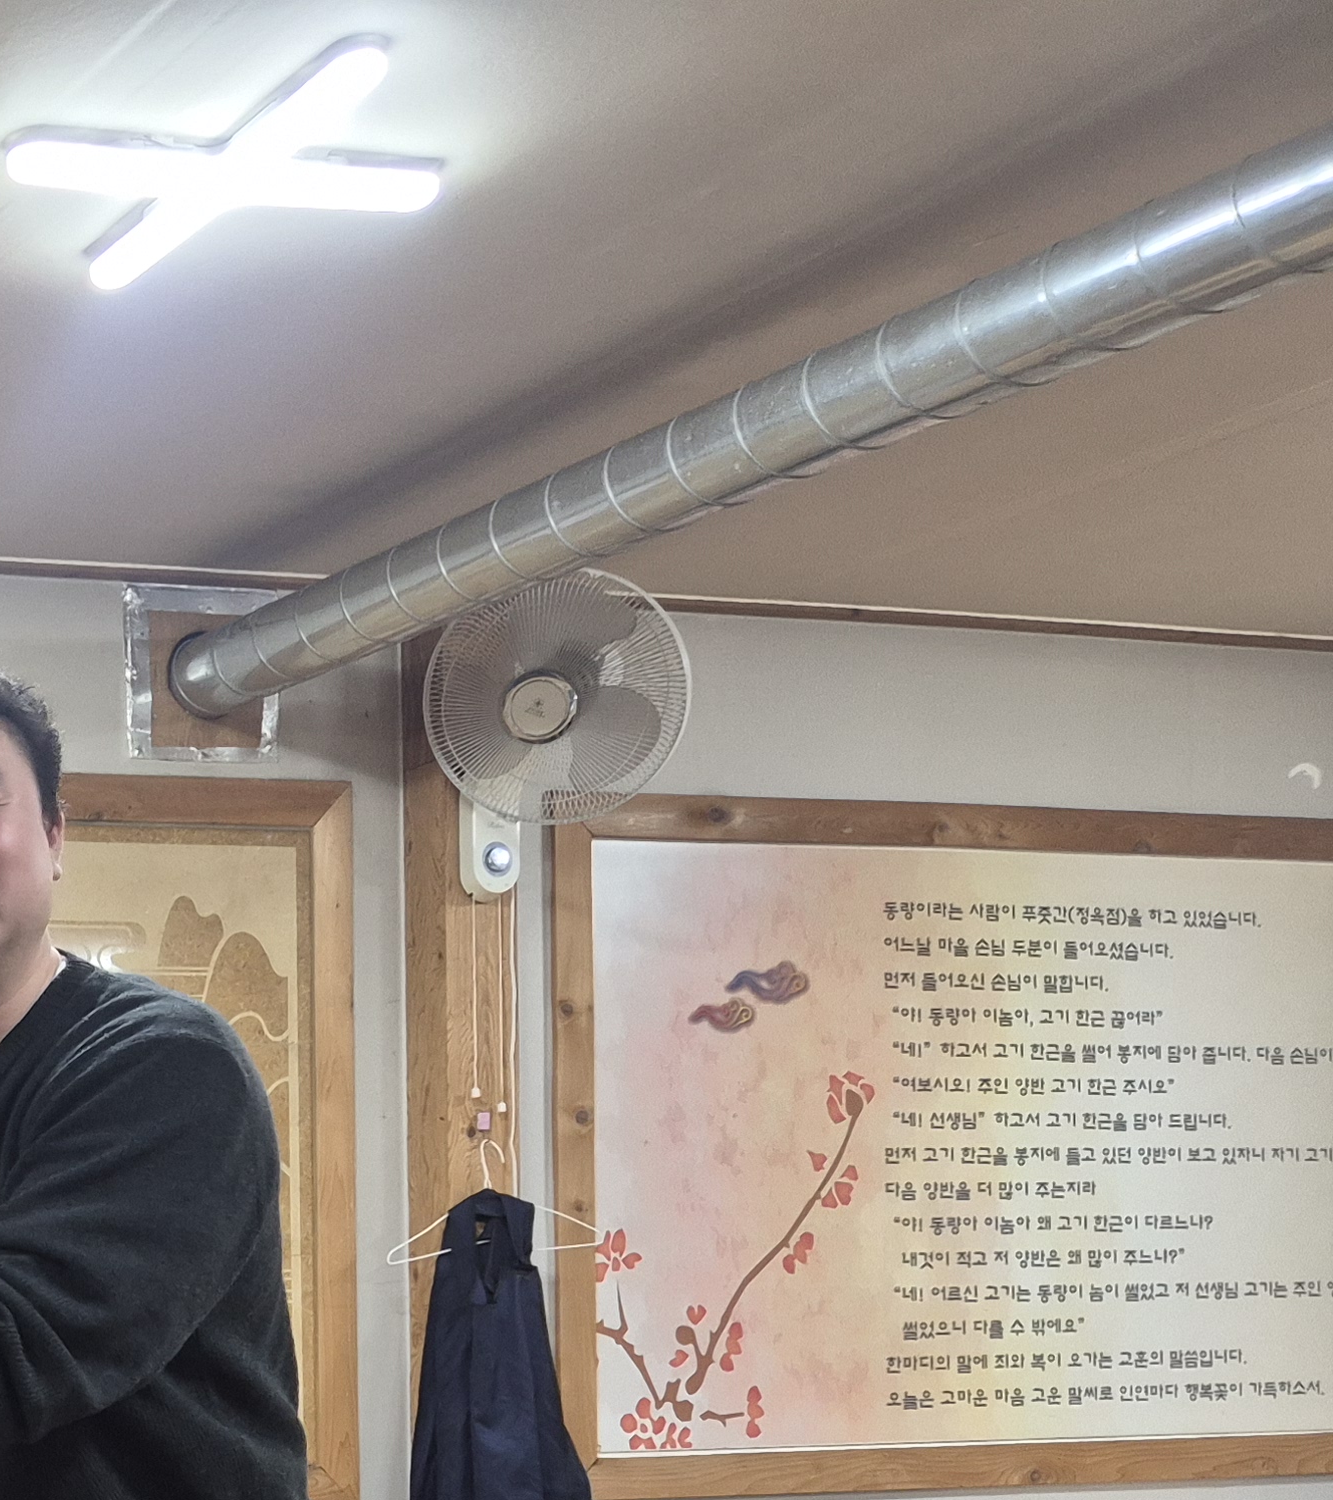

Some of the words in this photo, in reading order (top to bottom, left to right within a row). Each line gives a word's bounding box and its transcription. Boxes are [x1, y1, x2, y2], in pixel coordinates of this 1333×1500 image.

[969, 903, 1015, 922] 사람이
[1148, 909, 1178, 924] 하고
[1183, 910, 1261, 929] 있었습니다.
[884, 937, 931, 957] 어느날
[938, 937, 969, 957] 마을
[975, 938, 1005, 957] 손님
[1011, 939, 1057, 958] 두분이
[1063, 941, 1173, 961] 들어오셨습니다.
[884, 972, 915, 989] 먼저
[921, 972, 985, 992] 들어오신
[991, 973, 1037, 991] 손님이
[1044, 974, 1108, 994] 말합니다.
[983, 1008, 1033, 1027] 이놈아,
[1039, 1009, 1069, 1024] 고기
[1075, 1009, 1105, 1028] 한근
[940, 1042, 987, 1057] 하고서
[993, 1043, 1024, 1058] 고기
[1030, 1043, 1076, 1063] 한근을
[1082, 1044, 1111, 1063] 썰어
[1117, 1045, 1161, 1064] 봉지에
[1168, 1045, 1197, 1063] 담아
[1202, 1046, 1251, 1065] 줍니다.
[1256, 1047, 1285, 1065] 다음
[1290, 1047, 1332, 1064] 손님이
[977, 1077, 1009, 1094] 주인
[1015, 1077, 1045, 1096] 양반
[1051, 1078, 1081, 1093] 고기
[1087, 1078, 1117, 1096] 한근
[994, 1112, 1040, 1127] 하고서
[1046, 1112, 1076, 1127] 고기
[1082, 1113, 1127, 1132] 한근을
[1133, 1113, 1163, 1131] 담아
[1168, 1113, 1231, 1131] 드립니다.
[885, 1147, 916, 1164] 먼저
[922, 1147, 954, 1162] 고기
[961, 1147, 1008, 1166] 한근을
[1013, 1147, 1060, 1166] 봉지에
[1065, 1147, 1096, 1166] 들고
[1102, 1147, 1131, 1164] 있던
[1138, 1147, 1181, 1165] 양반이
[1187, 1148, 1217, 1161] 보고
[1222, 1147, 1265, 1165] 있자니
[1271, 1147, 1299, 1162] 자기
[1304, 1148, 1333, 1162] 고기
[885, 1182, 917, 1201] 다음
[923, 1181, 971, 1200] 양반을
[977, 1181, 992, 1196] 더
[998, 1181, 1028, 1200] 많이
[1035, 1181, 1096, 1199] 주는지라
[984, 1216, 1030, 1235] 이놈아
[1037, 1216, 1051, 1230] 왜
[1057, 1215, 1087, 1230] 고기
[1094, 1215, 1138, 1233] 한근이
[902, 1251, 949, 1269] 내것이
[956, 1251, 988, 1268] 적고
[994, 1250, 1008, 1265] 저
[1015, 1249, 1061, 1269] 양반은
[1067, 1250, 1081, 1264] 왜
[1088, 1249, 1117, 1268] 많이
[931, 1285, 978, 1303] 어르신
[984, 1285, 1031, 1302] 고기는
[1089, 1283, 1119, 1302] 놈이
[1125, 1283, 1170, 1302] 썰었고
[1175, 1282, 1189, 1296] 저
[1195, 1282, 1238, 1300] 선생님
[1244, 1281, 1288, 1298] 고기는
[1293, 1281, 1322, 1297] 주인
[903, 1320, 966, 1341] 썰었으니
[973, 1320, 1004, 1339] 다를
[1010, 1319, 1025, 1336] 수
[886, 1355, 950, 1374] 한마디의
[957, 1354, 988, 1374] 말에
[994, 1353, 1025, 1369] 죄와
[1030, 1353, 1061, 1372] 복이
[1067, 1352, 1113, 1369] 오가는
[1118, 1350, 1163, 1368] 교훈의
[1170, 1349, 1247, 1369] 말씀입니다.
[886, 1390, 935, 1410] 오늘은
[940, 1389, 988, 1407] 고마운
[995, 1388, 1025, 1407] 마음
[1031, 1387, 1062, 1405] 고운
[1068, 1386, 1114, 1405] 말씨로
[1120, 1384, 1178, 1402] 인연마다
[1184, 1382, 1242, 1401] 행복꽃이
[1249, 1380, 1325, 1399] 가득하소서.
